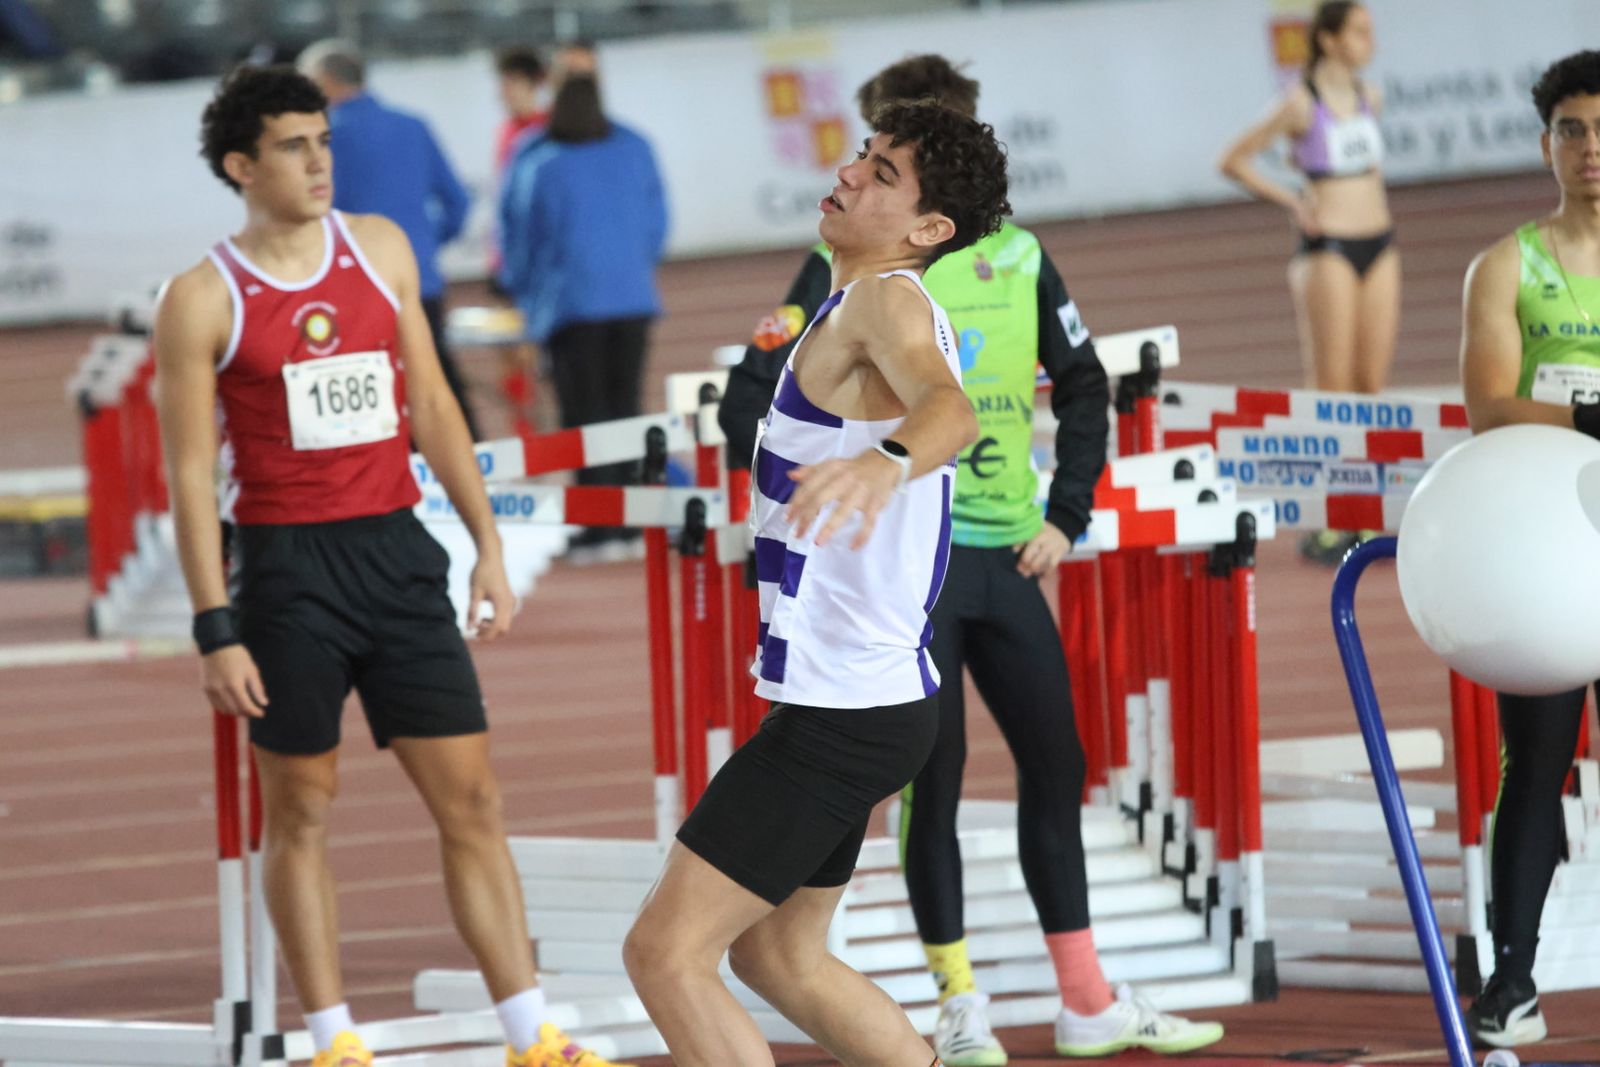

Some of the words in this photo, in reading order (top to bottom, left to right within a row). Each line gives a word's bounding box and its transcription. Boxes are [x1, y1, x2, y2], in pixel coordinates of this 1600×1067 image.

[1528, 322, 1551, 338] LA
[308, 373, 378, 418] 1686
[1316, 400, 1413, 428] MONDO
[1243, 434, 1340, 456] MONDO
